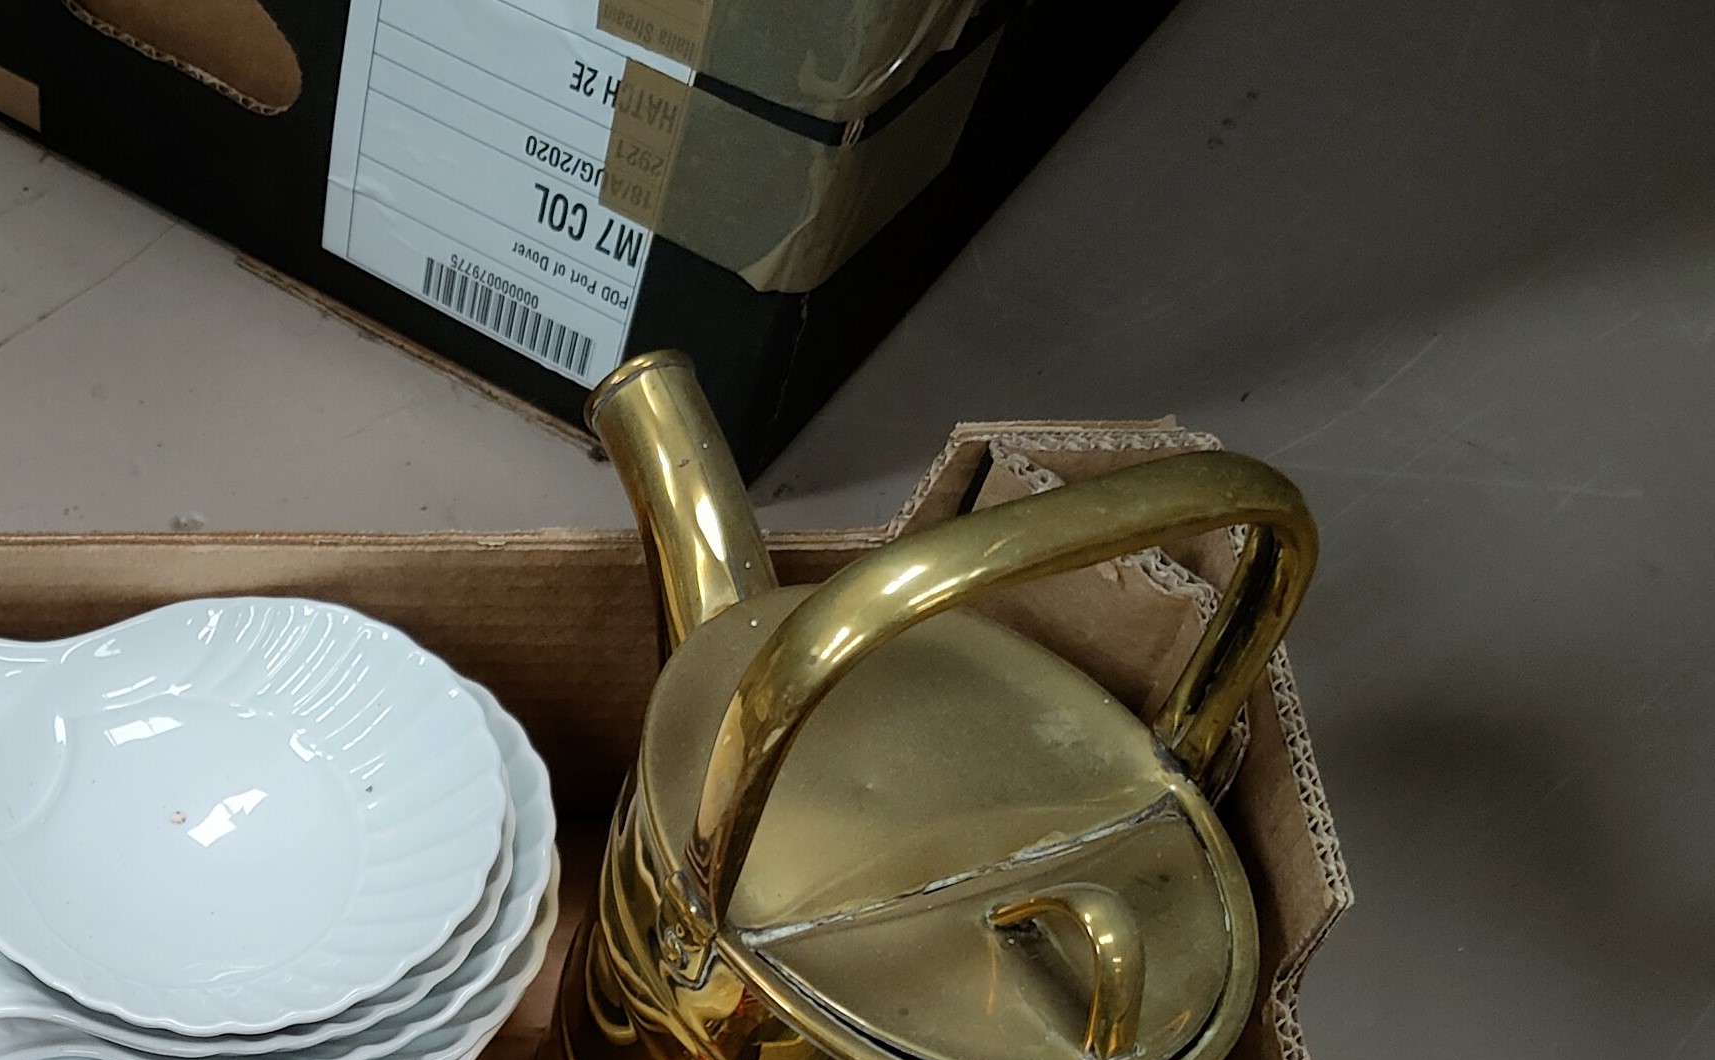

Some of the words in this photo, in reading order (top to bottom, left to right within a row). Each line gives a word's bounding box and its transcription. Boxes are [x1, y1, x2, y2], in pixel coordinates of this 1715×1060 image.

[570, 60, 598, 97] 2E
[602, 75, 678, 133] HATCH
[525, 135, 654, 209] 18/AUG/2020
[614, 138, 664, 177] 2921
[535, 183, 588, 242] COL
[511, 241, 549, 272] Dover
[595, 218, 643, 268] M7
[450, 254, 540, 310] 000000079775
[552, 261, 566, 277] of
[570, 269, 597, 295] Port
[601, 286, 630, 310] POD
